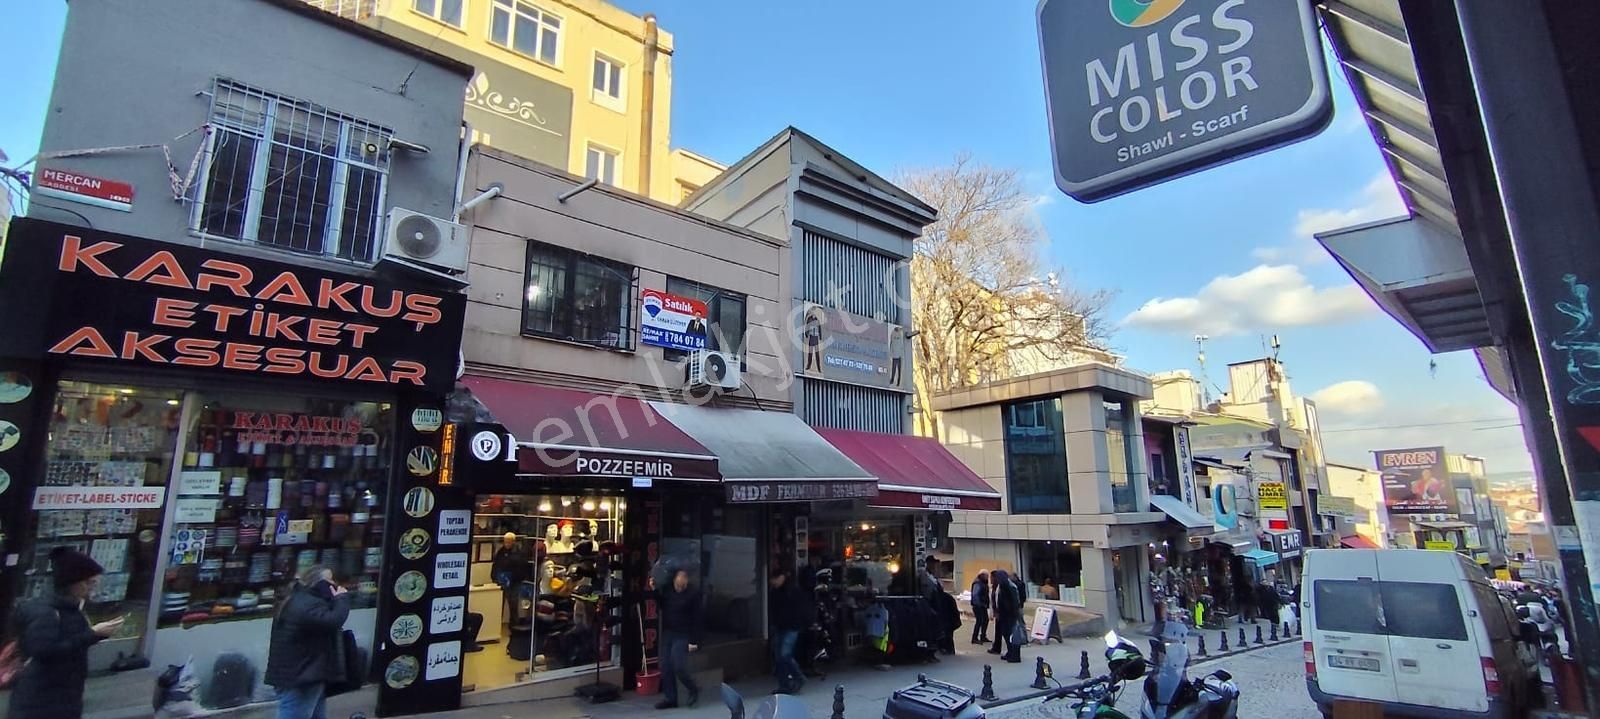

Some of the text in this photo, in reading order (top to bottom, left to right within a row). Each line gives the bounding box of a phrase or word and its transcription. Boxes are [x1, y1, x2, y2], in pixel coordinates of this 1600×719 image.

[1085, 0, 1255, 106] MISS
[1090, 56, 1258, 143] COLOR
[1117, 132, 1174, 162] Shawl
[1191, 104, 1249, 137] Scarf
[44, 169, 102, 189] MERCAN
[58, 234, 443, 332] KARAKUŞ
[665, 298, 693, 313] Satılık
[152, 297, 380, 349] ETİKET
[670, 332, 683, 344] 784
[685, 336, 694, 346] 07
[48, 326, 428, 386] AKSESUAR
[484, 441, 491, 451] P
[576, 458, 673, 476] POZZEEMİR
[1383, 451, 1437, 466] EVREN
[732, 485, 770, 500] MDF
